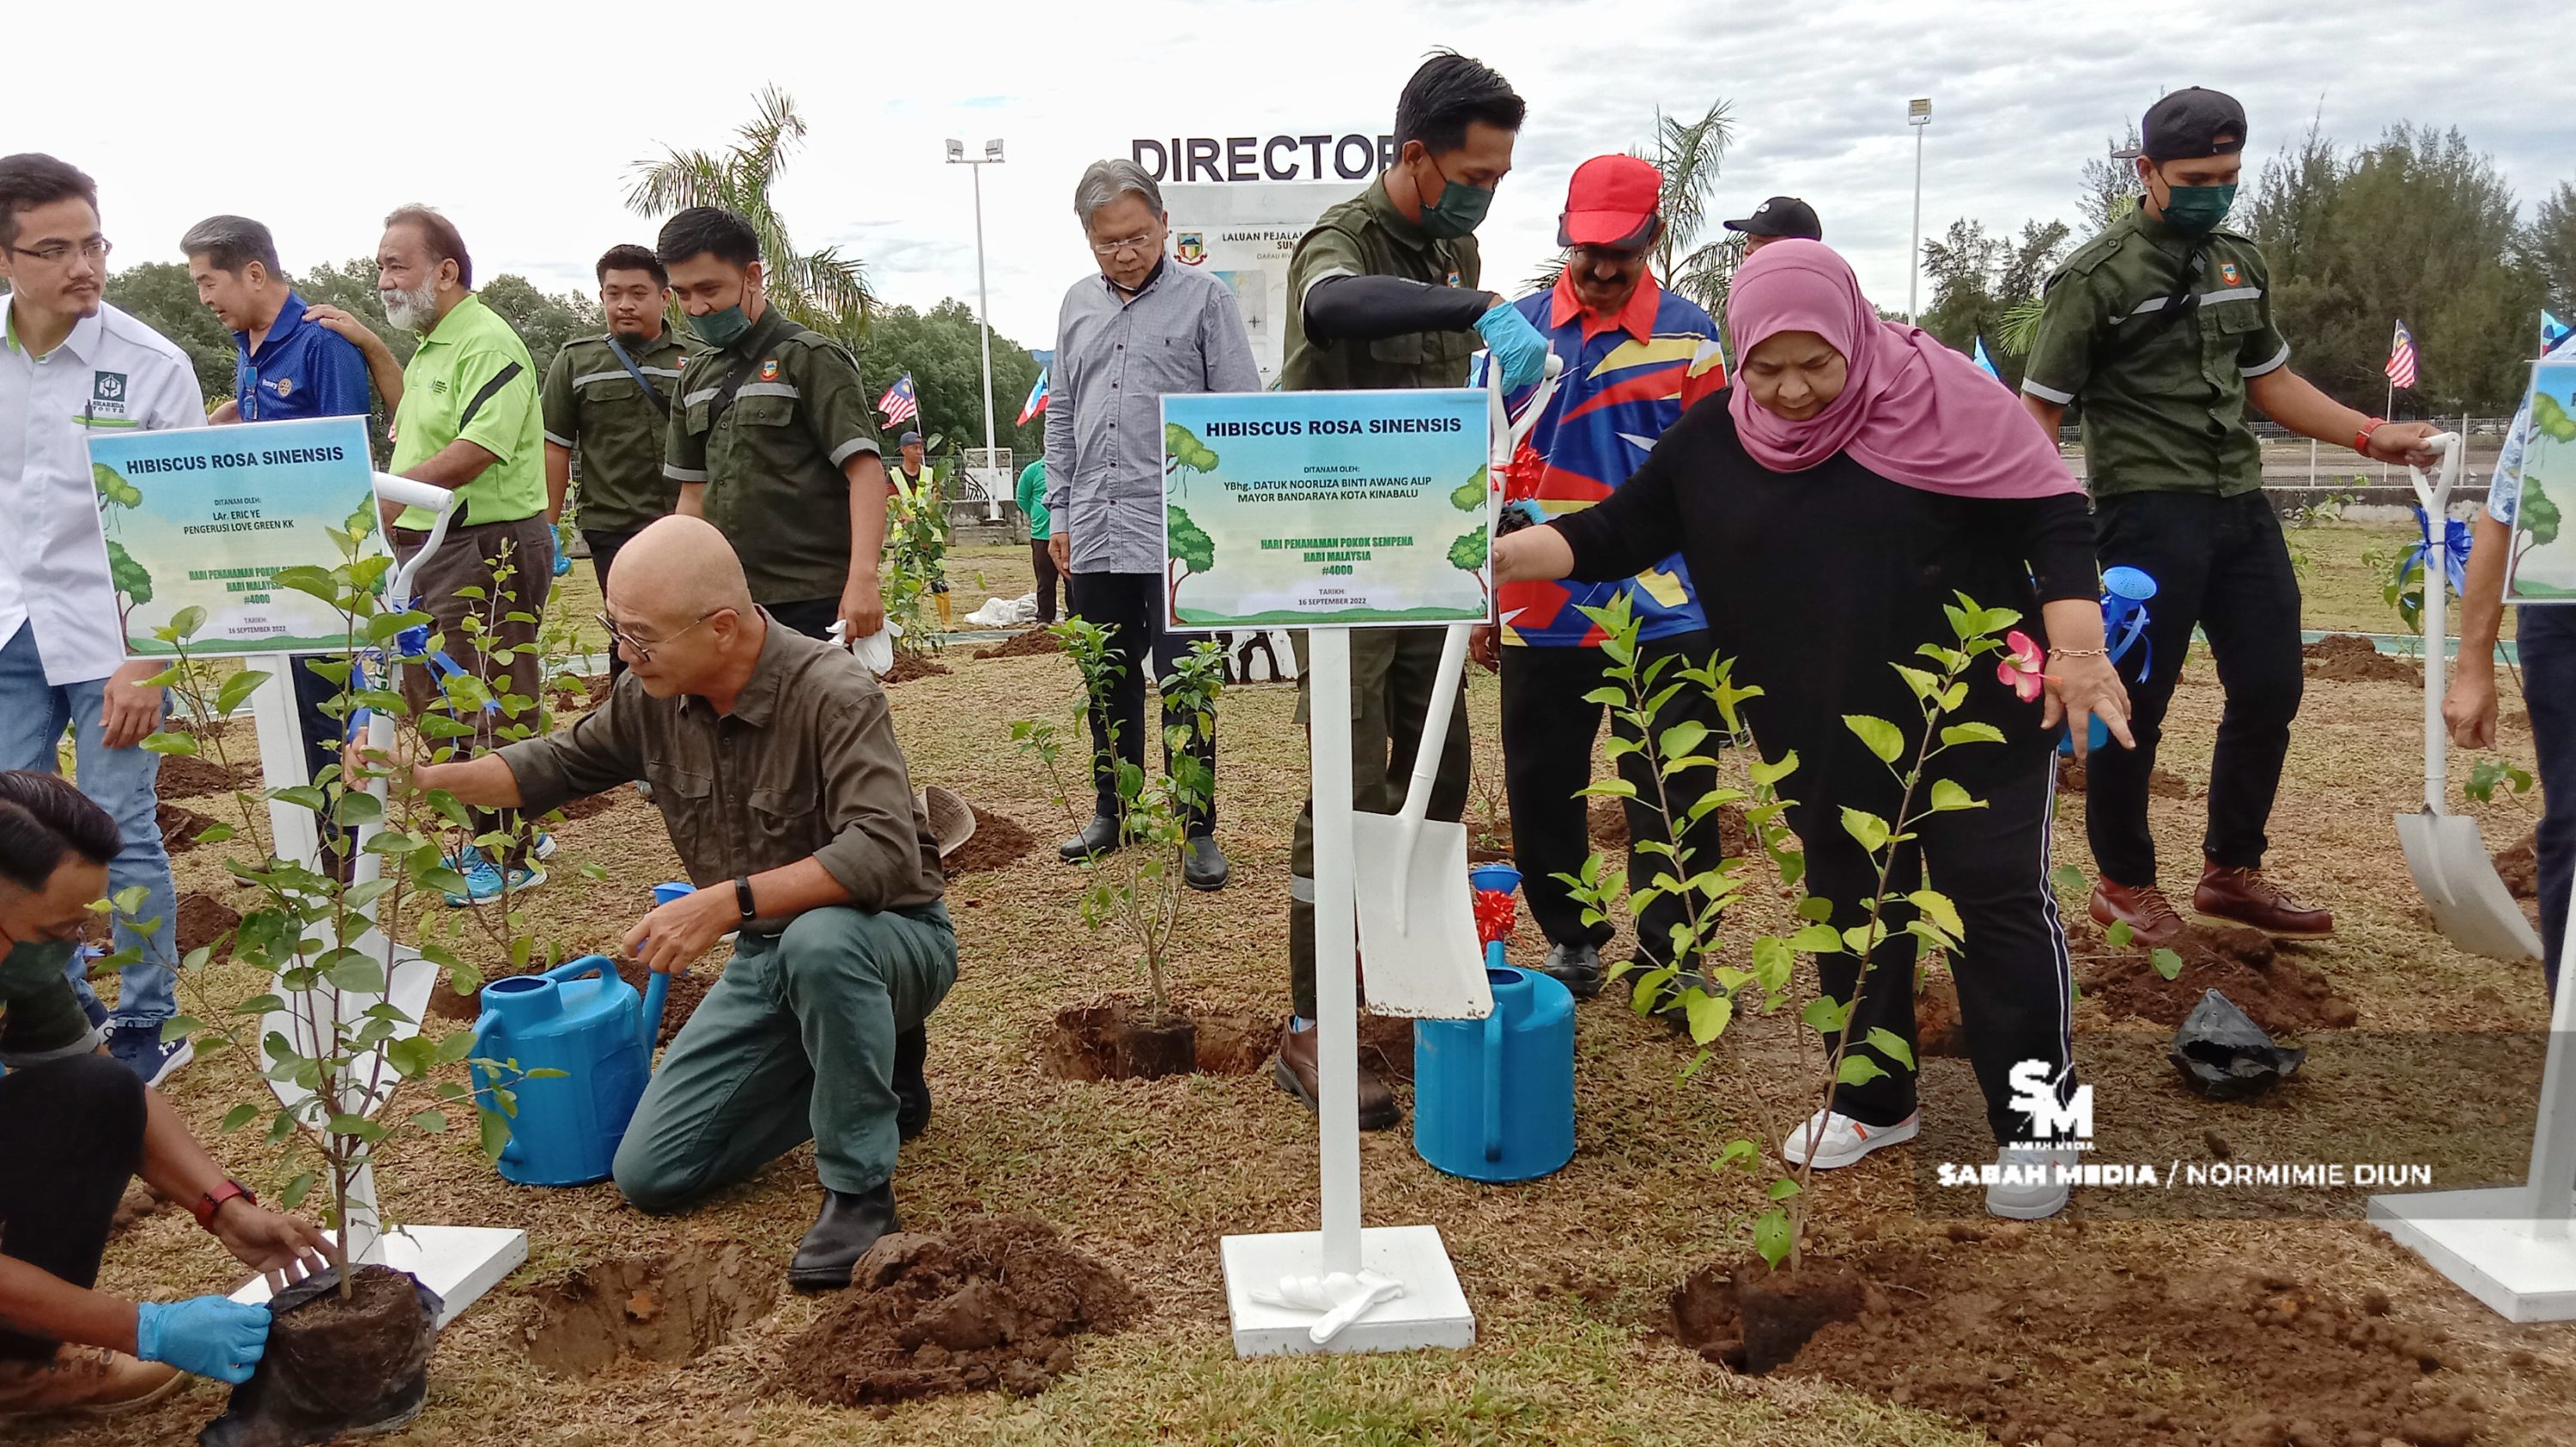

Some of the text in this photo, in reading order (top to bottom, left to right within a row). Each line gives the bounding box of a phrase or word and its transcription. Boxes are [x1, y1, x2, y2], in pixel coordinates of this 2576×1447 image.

[1222, 231, 1303, 241] LALUAN PEJALA
[1206, 417, 1461, 437] HIBISCUS ROSA SINENSIS
[126, 446, 344, 475] HIBISCUS ROSA SINENSIS
[1224, 477, 1431, 492] YBhg. DATUK NOORLIZA BINTI AWANG ALIP
[1238, 489, 1419, 503] MAYOR BANDARAYA KOTA KINABALU
[214, 498, 243, 507] DITANAM
[231, 510, 249, 520] ERIC
[250, 509, 261, 519] YE
[183, 520, 295, 535] PENGERUSI LOVE GREEN KK
[1261, 536, 1413, 550] HARI PENANAMAN POKOK SEMPENA
[1303, 550, 1371, 562] HARI MALAYSIA
[189, 570, 208, 581] HARI
[209, 568, 254, 580] PENANAMAN
[1321, 565, 1353, 575] #4000
[226, 581, 284, 593] HARI MALAYSI
[244, 594, 270, 605] #4000
